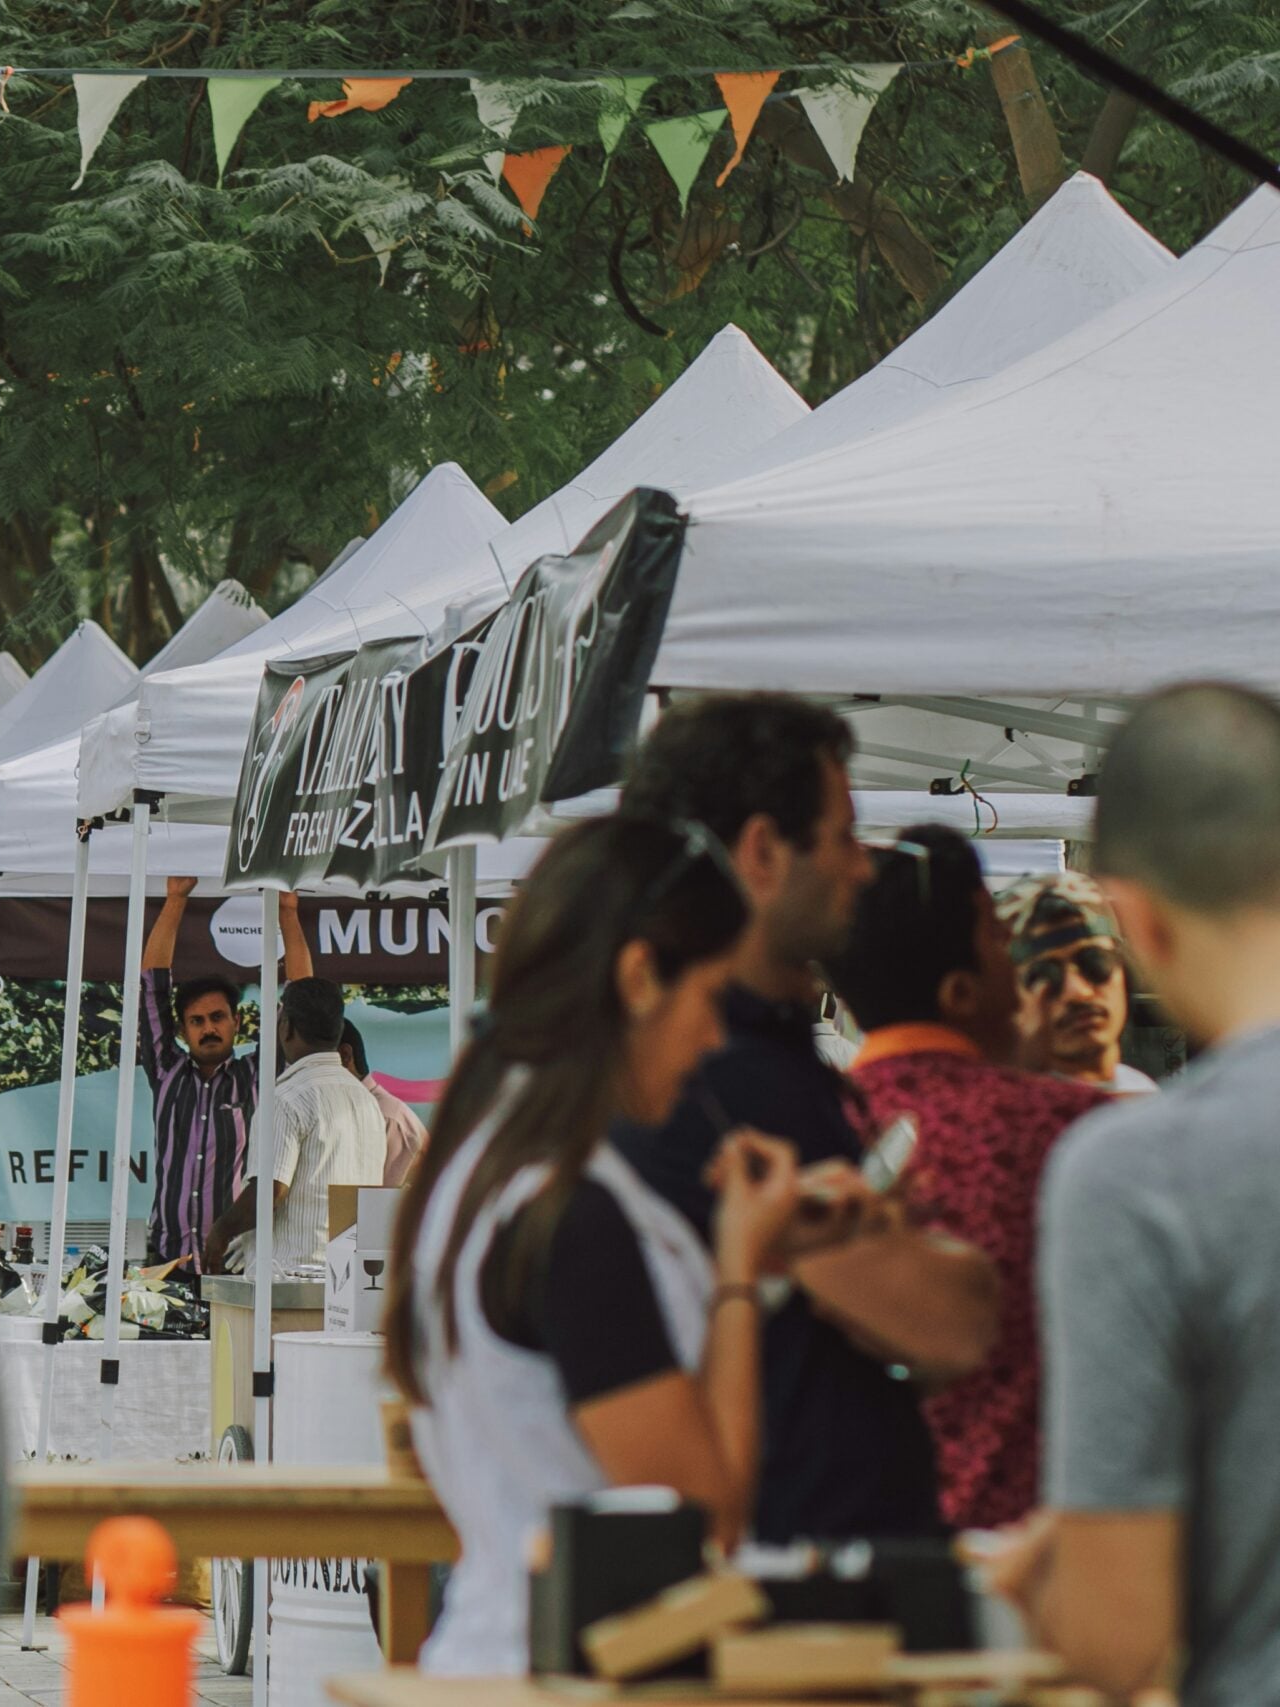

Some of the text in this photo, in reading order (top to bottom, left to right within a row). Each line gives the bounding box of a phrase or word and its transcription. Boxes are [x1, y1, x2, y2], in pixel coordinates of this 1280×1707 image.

[283, 808, 333, 857] FRESH
[454, 751, 490, 807] IN
[219, 925, 264, 936] MUNCHE
